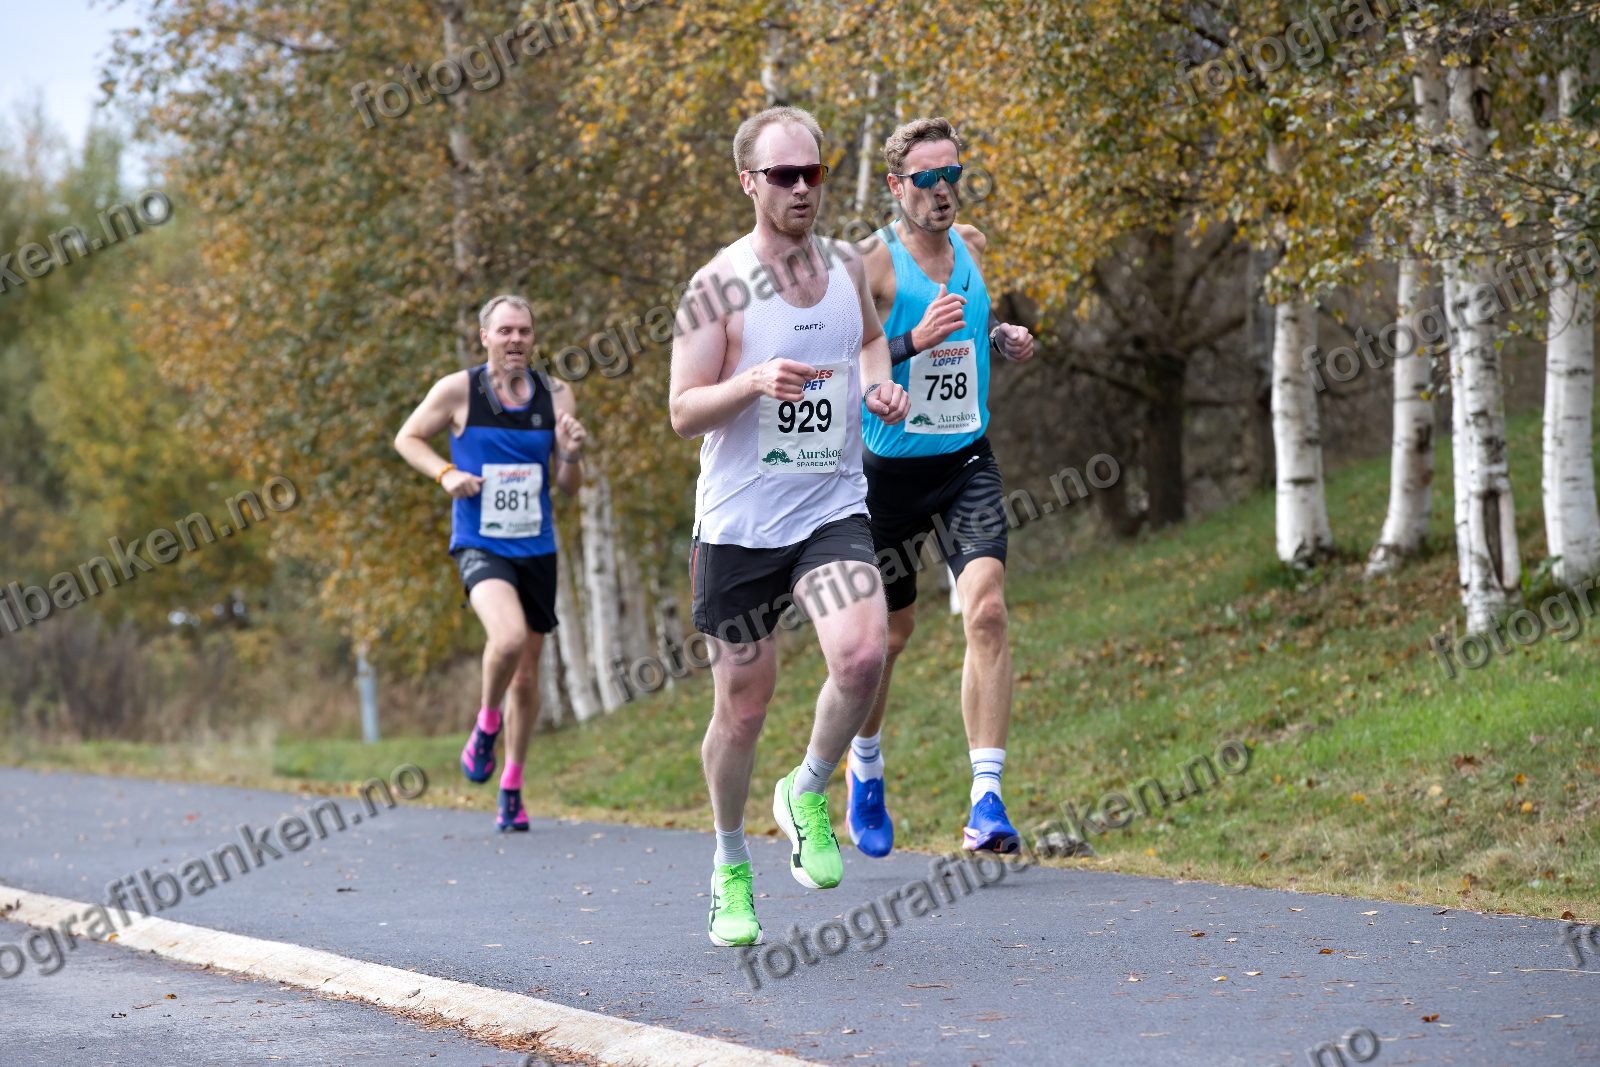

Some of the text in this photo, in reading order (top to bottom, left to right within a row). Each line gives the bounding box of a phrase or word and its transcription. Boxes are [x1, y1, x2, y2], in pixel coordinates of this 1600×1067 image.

[794, 323, 819, 331] CRAFT
[930, 347, 970, 358] NORGES
[932, 357, 963, 367] LØPET
[925, 372, 967, 401] 758
[778, 398, 832, 434] 929
[937, 411, 977, 423] Aurskog
[495, 489, 529, 511] 881
